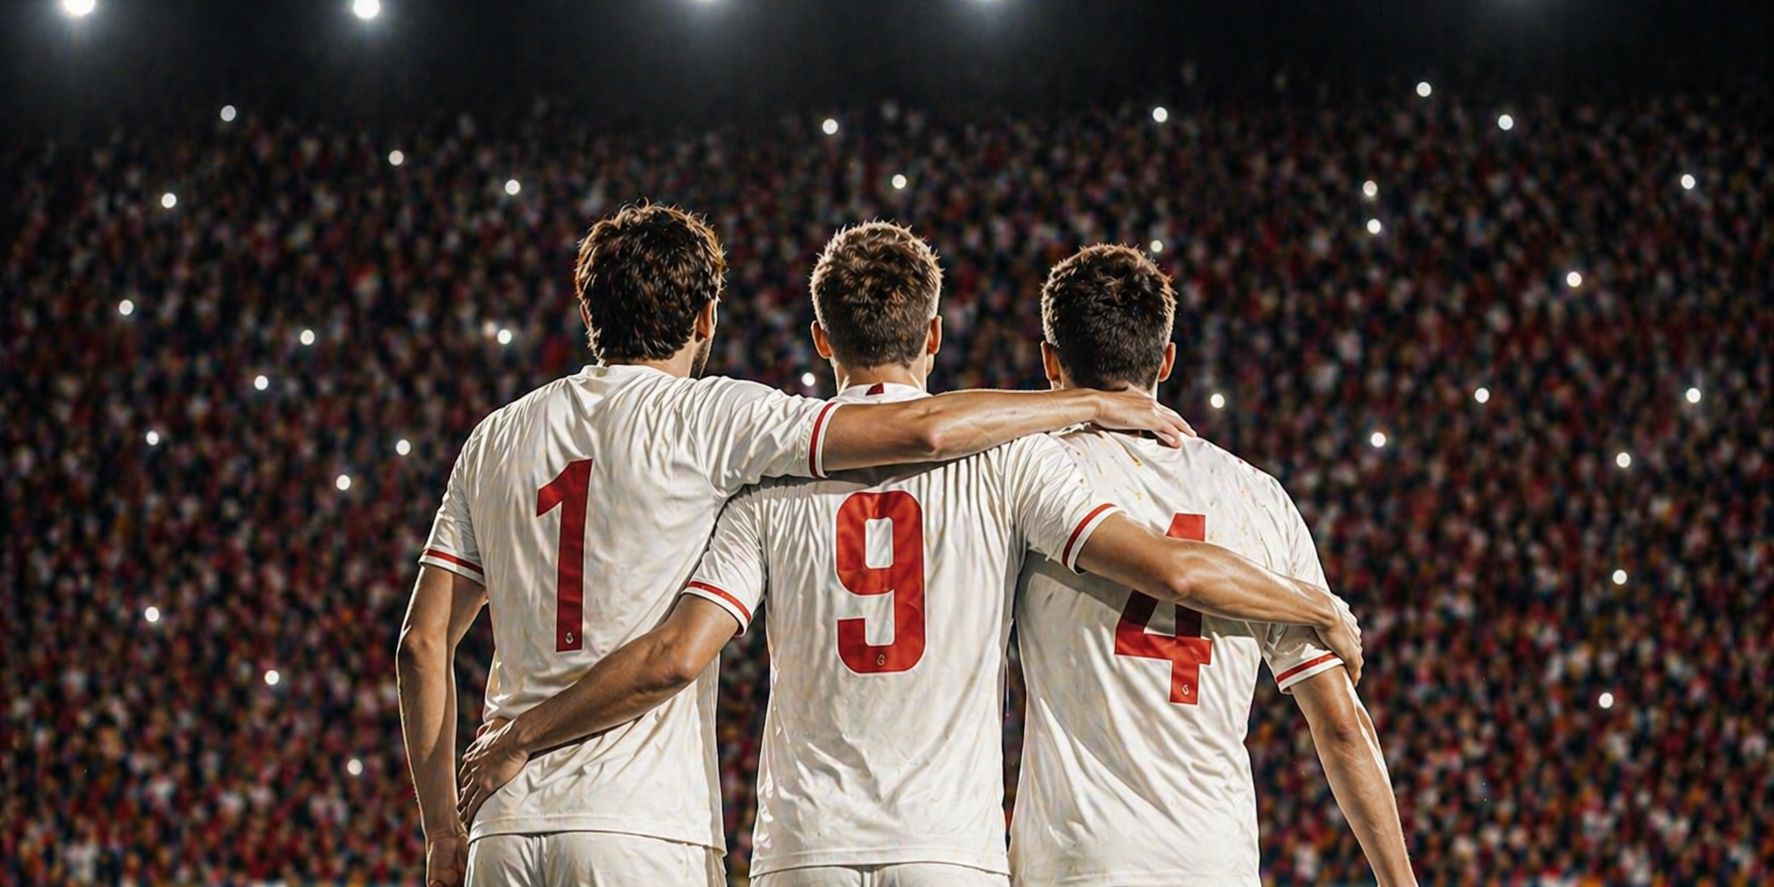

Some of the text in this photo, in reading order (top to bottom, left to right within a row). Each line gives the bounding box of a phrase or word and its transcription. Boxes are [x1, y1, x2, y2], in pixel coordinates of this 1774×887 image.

[536, 458, 592, 653] 1
[836, 490, 926, 674] 9
[1114, 512, 1213, 705] 4
